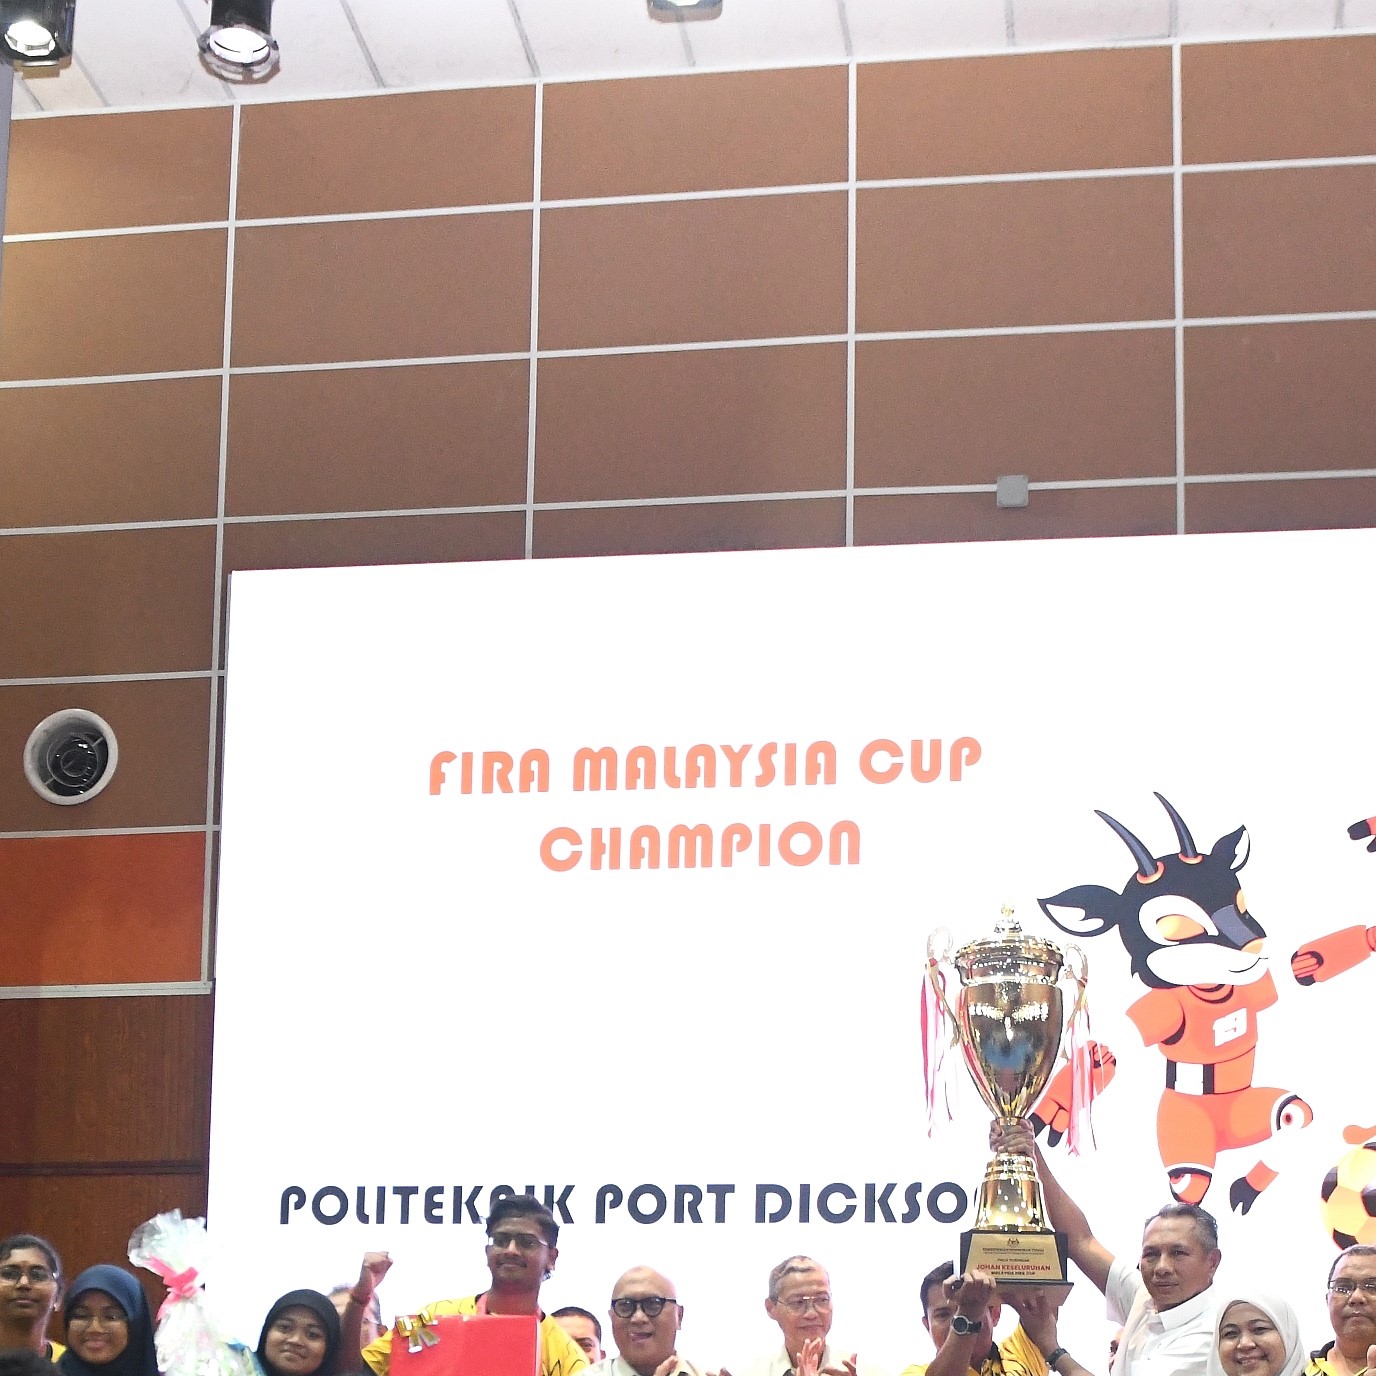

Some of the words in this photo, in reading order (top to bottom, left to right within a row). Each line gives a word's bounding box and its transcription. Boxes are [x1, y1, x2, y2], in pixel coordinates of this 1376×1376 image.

[429, 748, 550, 795] FIRA
[572, 740, 837, 792] MALAYSIA
[859, 736, 982, 785] CUP
[539, 820, 861, 872] CHAMPION
[279, 1184, 576, 1226] POLITEKK
[595, 1182, 735, 1225] PORT
[755, 1181, 977, 1224] DICKSO
